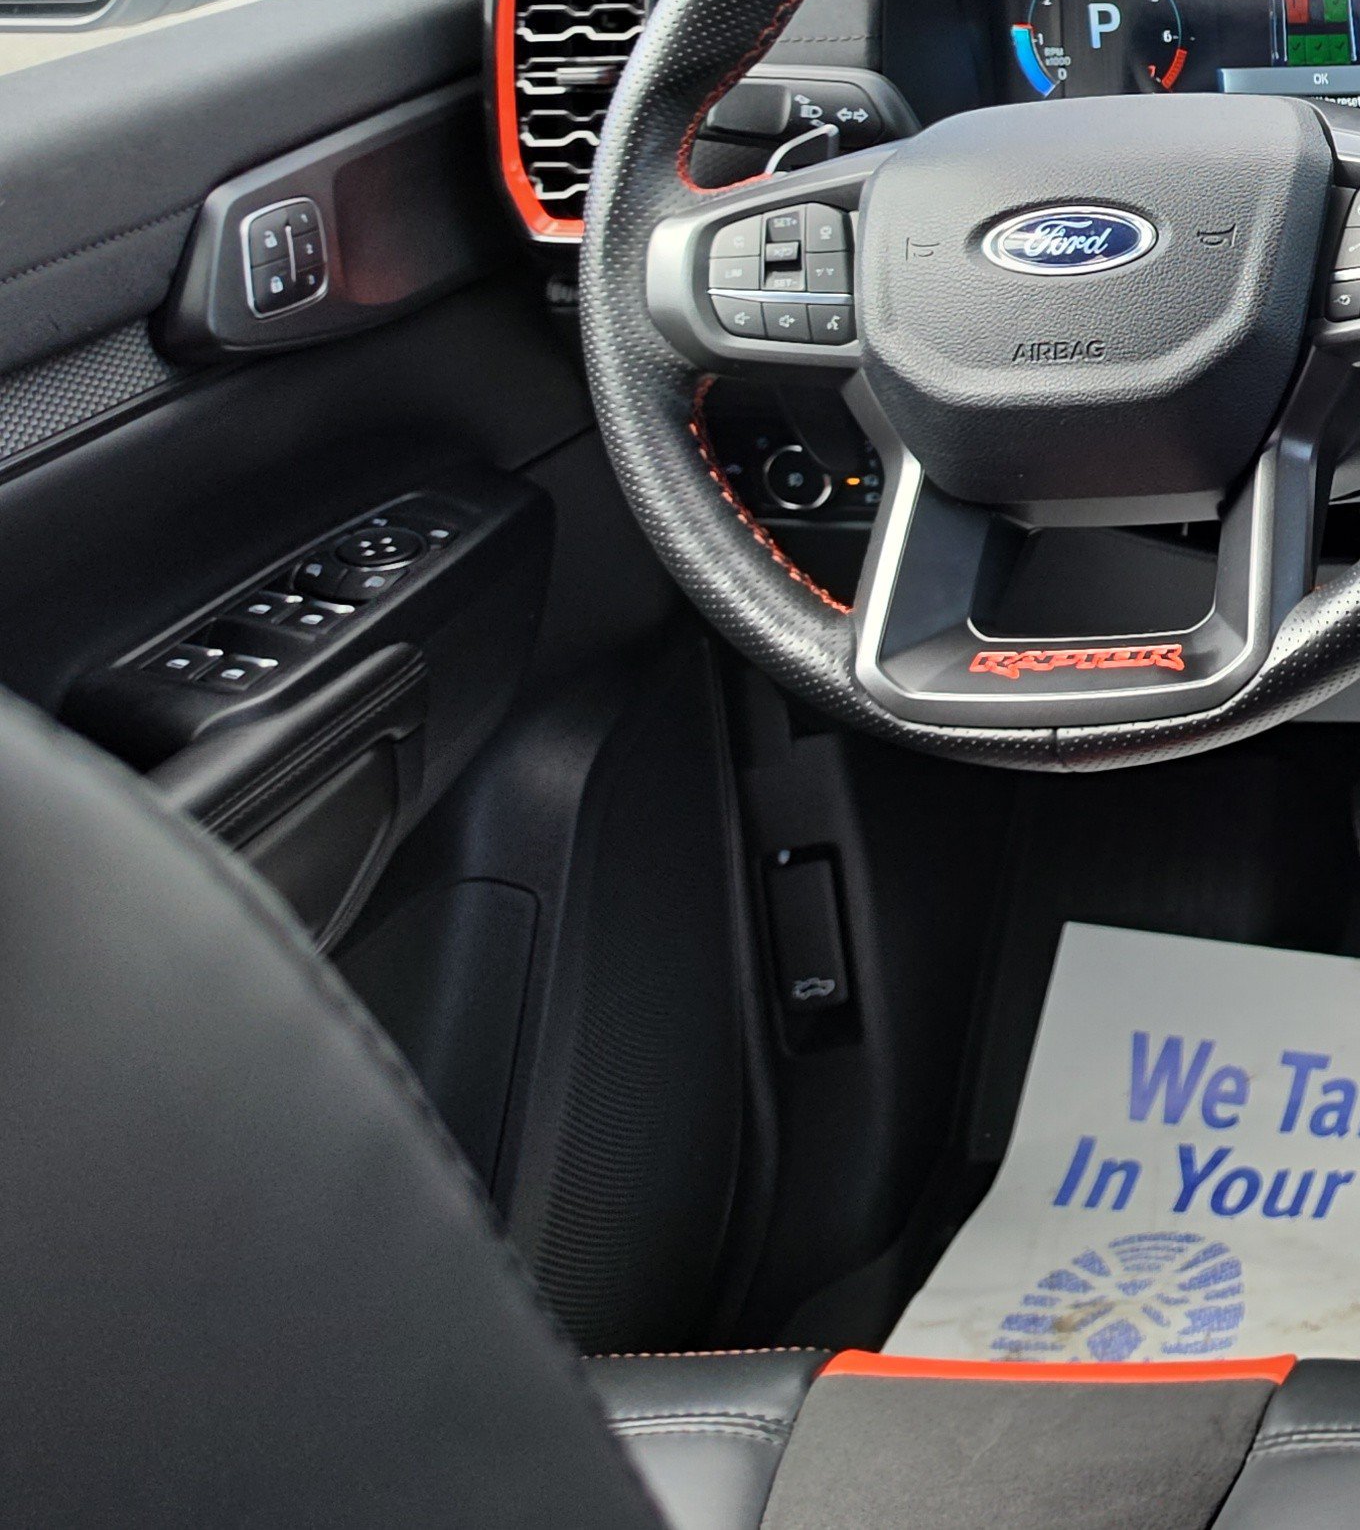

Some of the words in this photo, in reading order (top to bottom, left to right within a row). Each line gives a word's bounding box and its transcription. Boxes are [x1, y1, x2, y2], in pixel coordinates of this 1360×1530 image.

[1087, 2, 1121, 49] P
[1162, 30, 1172, 43] 6
[1313, 72, 1329, 85] OK
[1022, 219, 1108, 257] Ford
[1011, 339, 1106, 364] AIRBAG
[1125, 1030, 1249, 1129] We
[1050, 1136, 1142, 1212] In
[1168, 1142, 1353, 1220] Your
